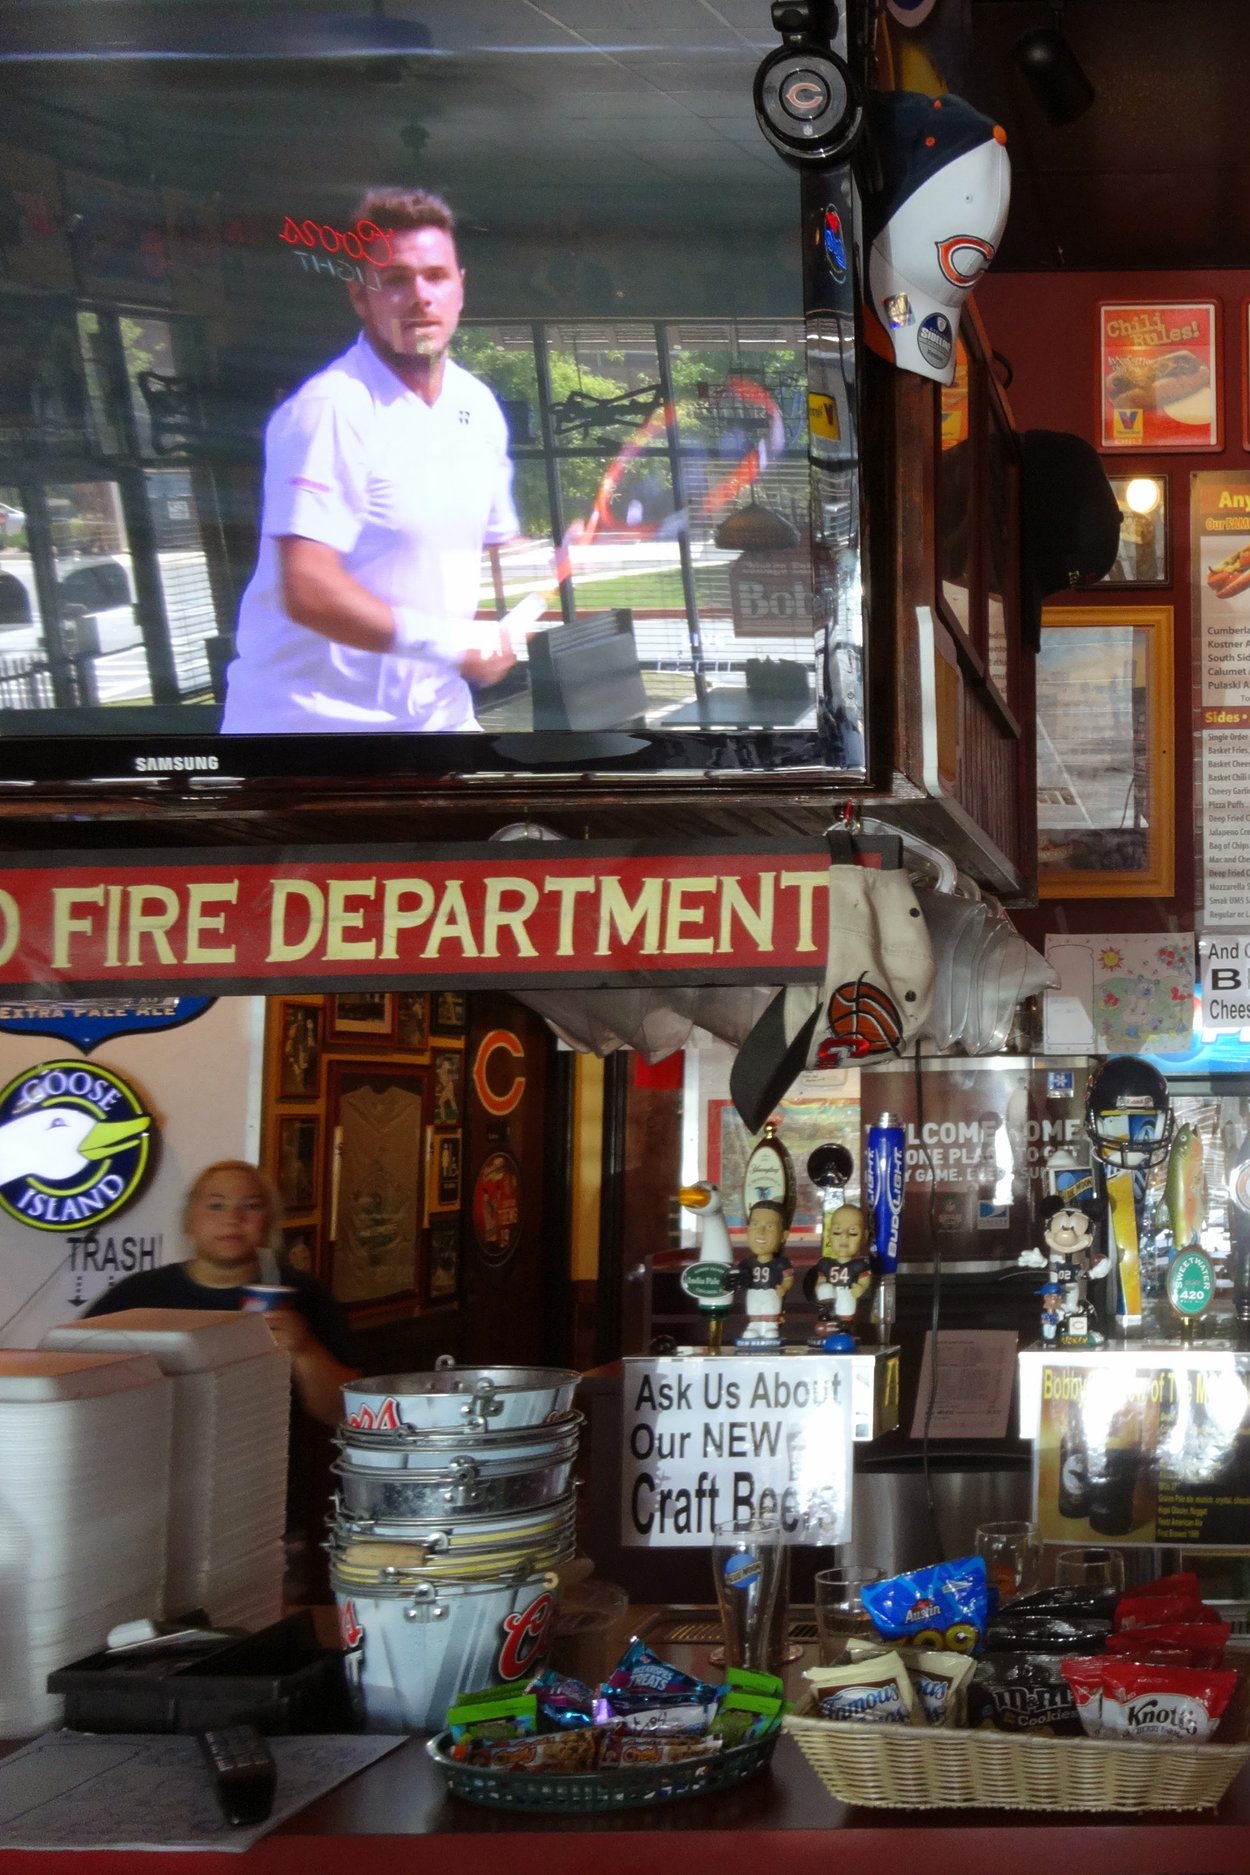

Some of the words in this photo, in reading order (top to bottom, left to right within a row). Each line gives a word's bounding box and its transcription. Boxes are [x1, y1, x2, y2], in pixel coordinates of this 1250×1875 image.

[1107, 313, 1161, 338] Chili
[1130, 321, 1200, 348] Rules!
[1206, 711, 1240, 723] Sides
[135, 756, 219, 771] SAMSUNG
[52, 879, 239, 968] FIRE
[266, 871, 830, 962] DEPARTMENT
[1208, 943, 1239, 959] And
[22, 1072, 122, 1111] GOOSE
[893, 1148, 904, 1202] LIGHT
[16, 1175, 124, 1221] ISLAND
[888, 1214, 901, 1257] BUD
[66, 1237, 155, 1271] TRASH
[753, 1267, 769, 1282] 99
[830, 1267, 849, 1282] 54
[1174, 1257, 1210, 1290] SWEETWATER
[1180, 1291, 1205, 1299] 420
[635, 1375, 693, 1410] Ask
[704, 1373, 740, 1409] Us
[750, 1372, 842, 1408] About
[631, 1423, 691, 1460] Our
[703, 1421, 782, 1457] NEW
[632, 1472, 719, 1534] Craft
[905, 1604, 941, 1624] Austin
[631, 1673, 667, 1691] TREATS
[821, 1684, 899, 1720] Famous
